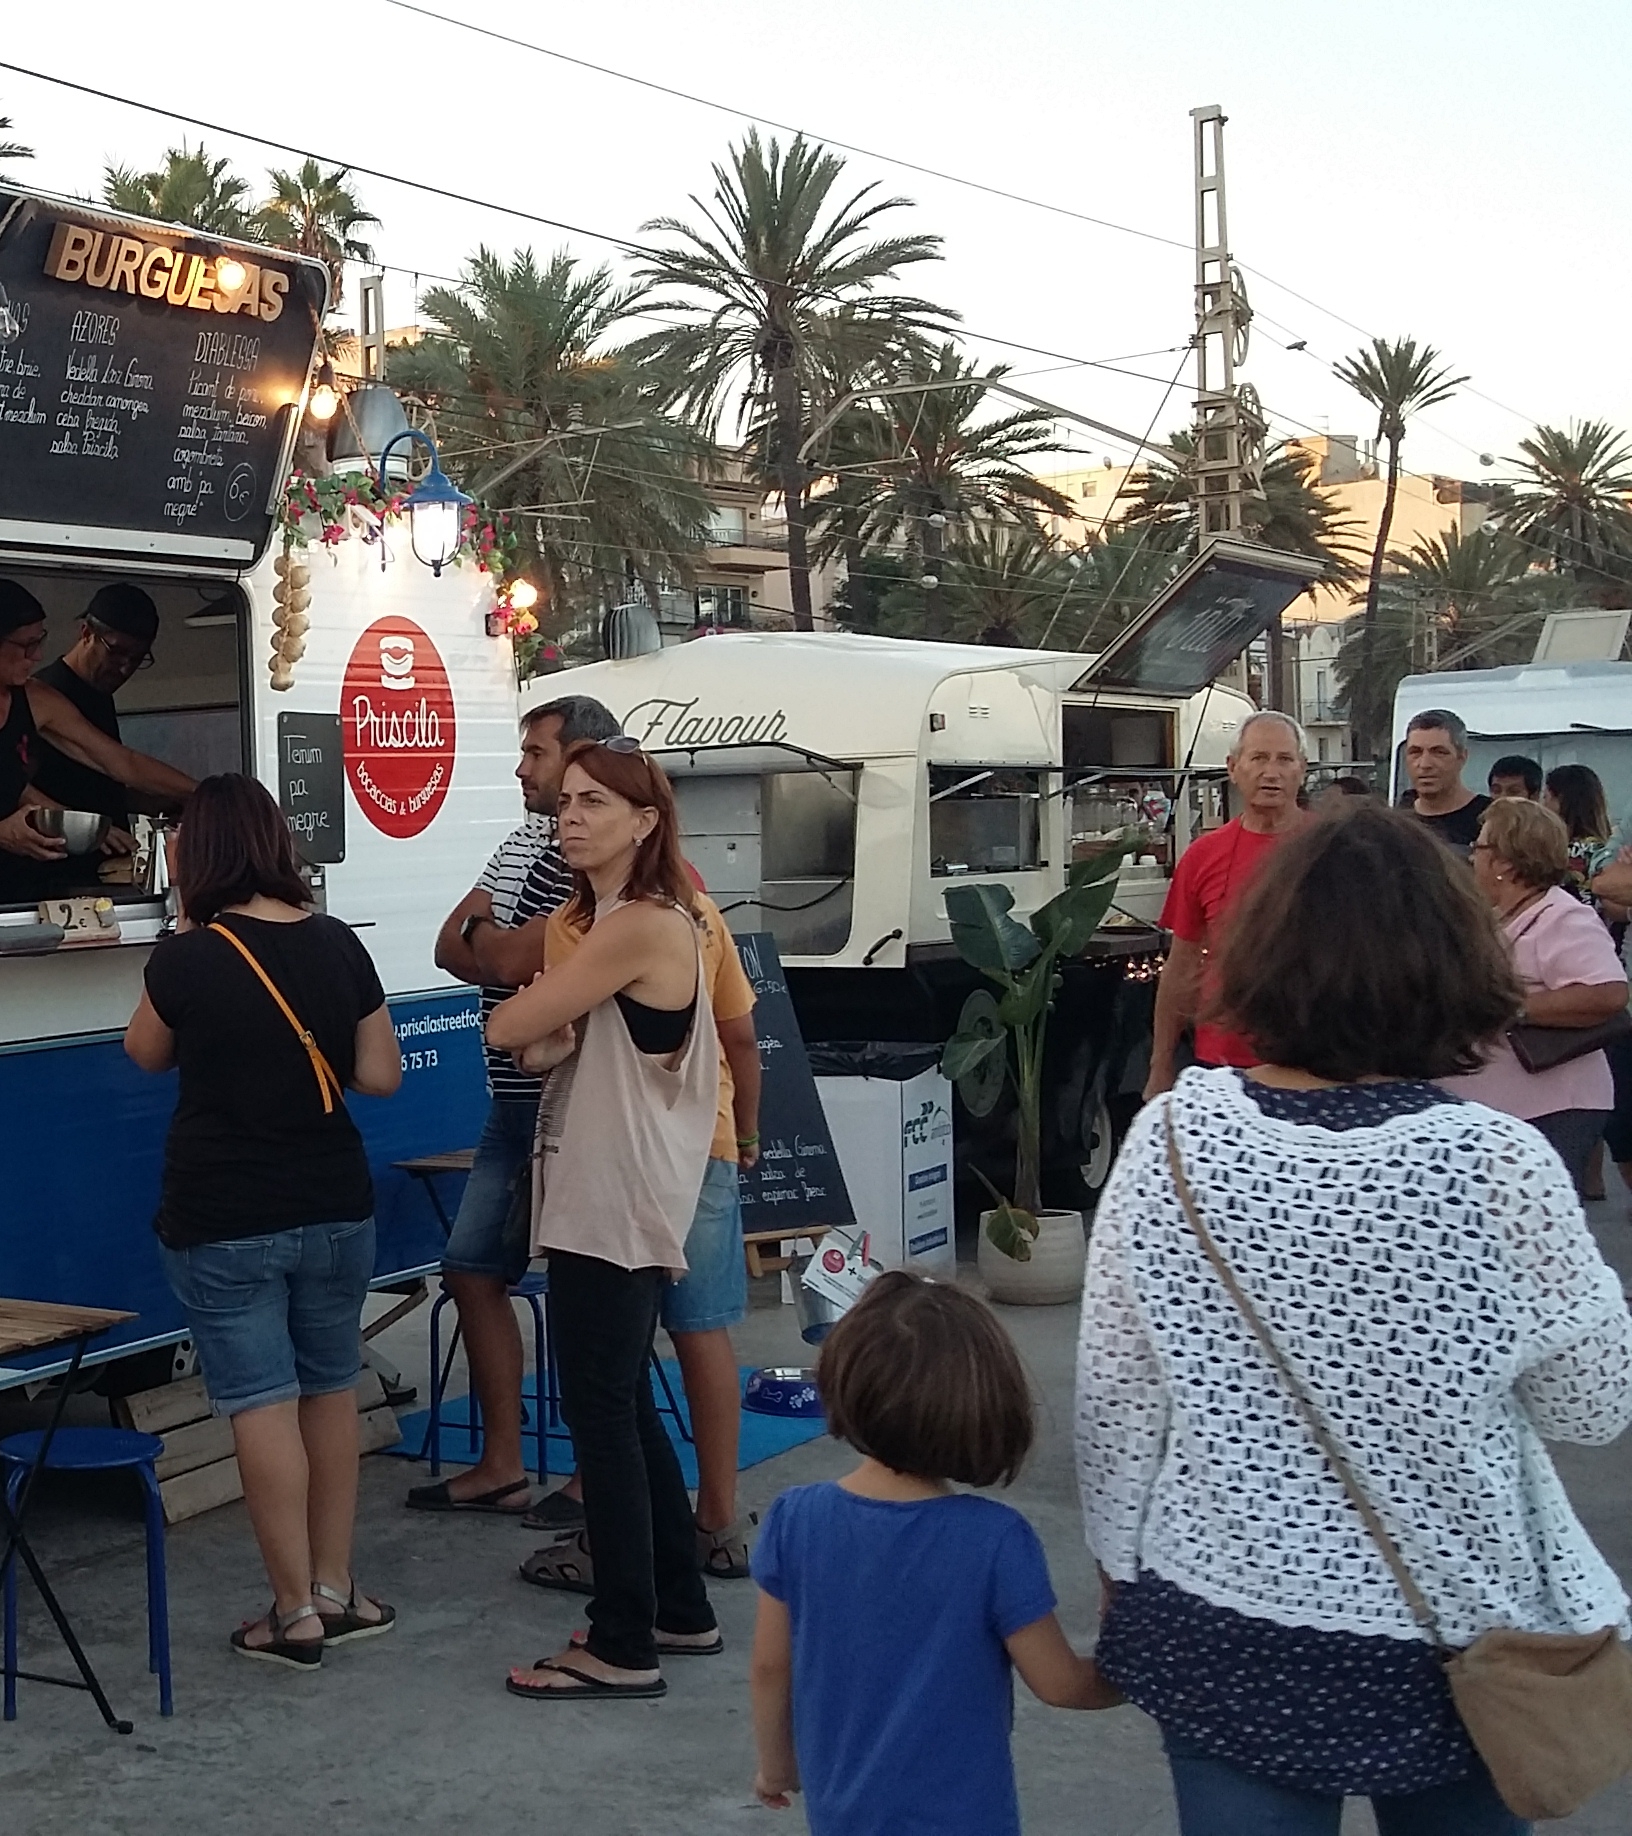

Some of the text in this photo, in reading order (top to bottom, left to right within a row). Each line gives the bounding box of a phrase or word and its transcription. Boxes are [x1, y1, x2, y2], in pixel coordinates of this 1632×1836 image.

[70, 310, 120, 346] AZORES
[65, 348, 98, 383] Vedella
[194, 331, 261, 372] DIABLESSA
[12, 379, 27, 399] de
[60, 384, 104, 407] cheddar
[188, 367, 220, 398] Picant
[224, 374, 236, 399] de
[56, 407, 79, 428] ceba
[177, 418, 207, 439] salsa
[49, 430, 119, 460] salsa Priscila
[166, 466, 193, 493] amb
[352, 694, 445, 748] Priscila
[621, 697, 788, 745] Flavour
[283, 734, 322, 764] Tenim
[289, 778, 308, 806] pa
[356, 760, 444, 816] bocaccias & burguesas
[287, 811, 330, 842] negre
[409, 1051, 423, 1070] 75
[425, 1049, 438, 1068] 73
[795, 1159, 807, 1178] de
